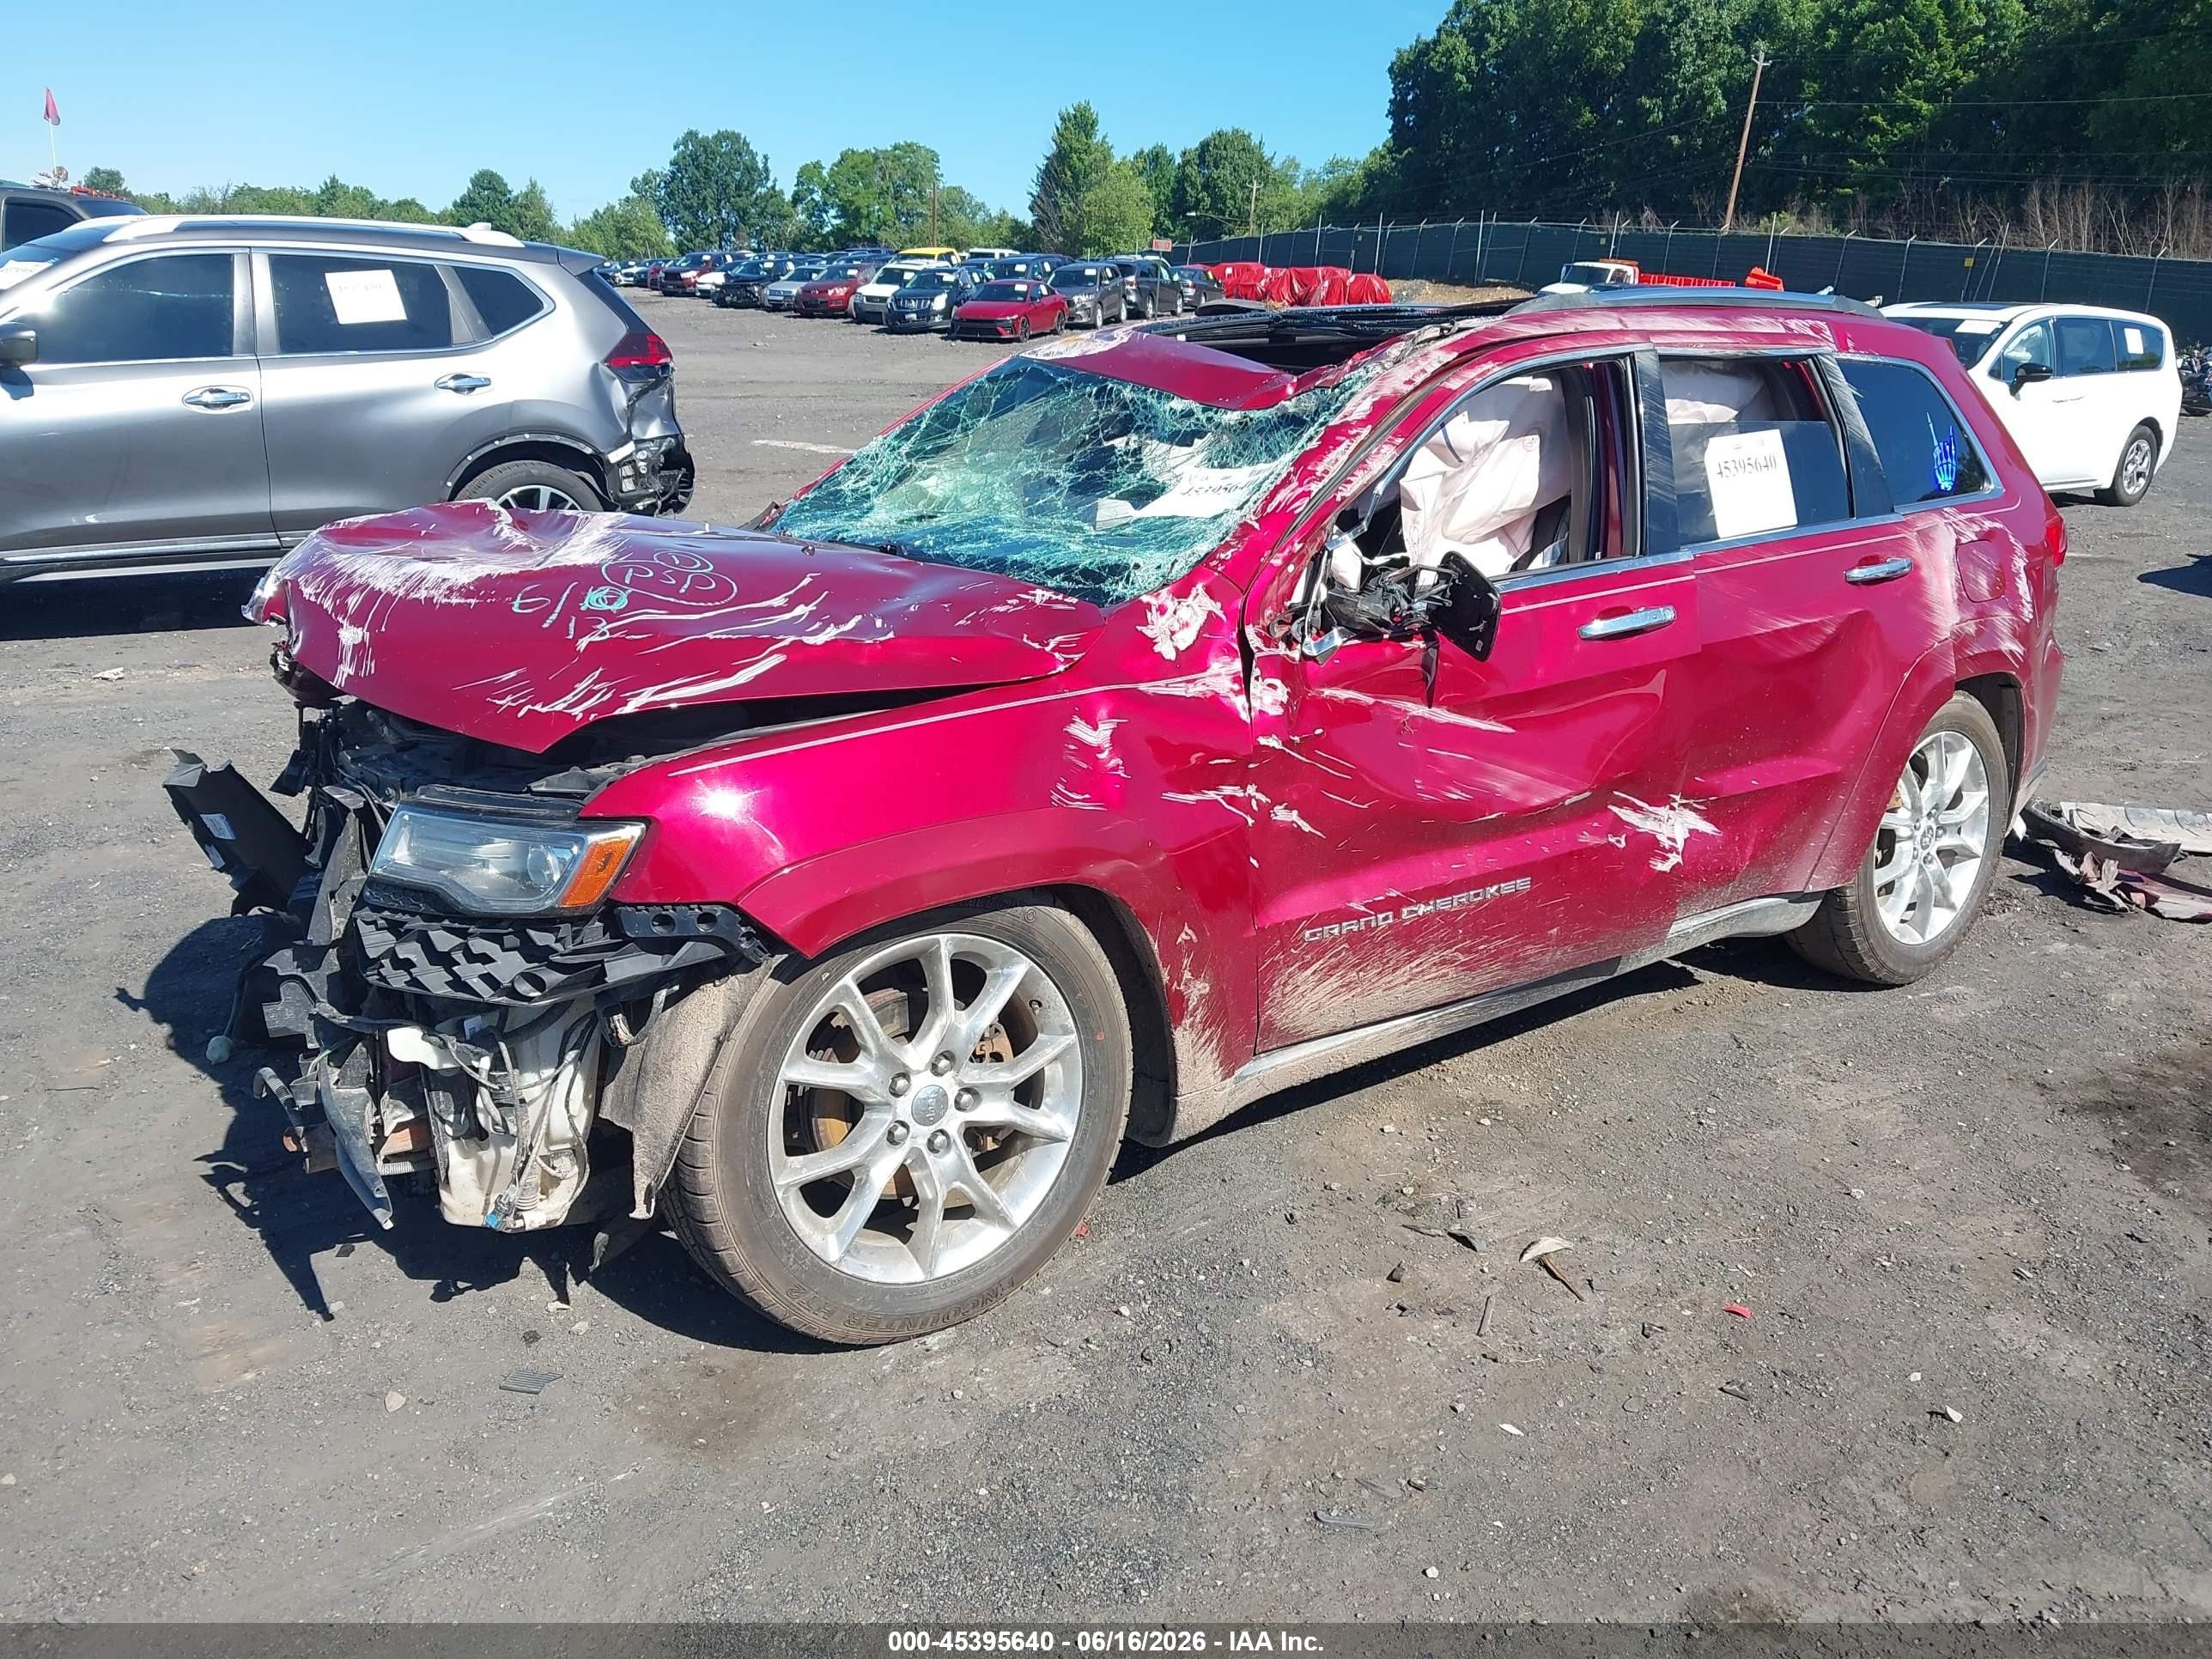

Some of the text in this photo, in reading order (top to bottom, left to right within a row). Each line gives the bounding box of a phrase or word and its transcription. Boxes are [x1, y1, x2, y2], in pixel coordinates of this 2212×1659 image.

[1717, 454, 1778, 478] 45395640
[1304, 877, 1532, 943] GRAND CHEROKEE
[843, 1276, 1015, 1333] ENCOUNTER
